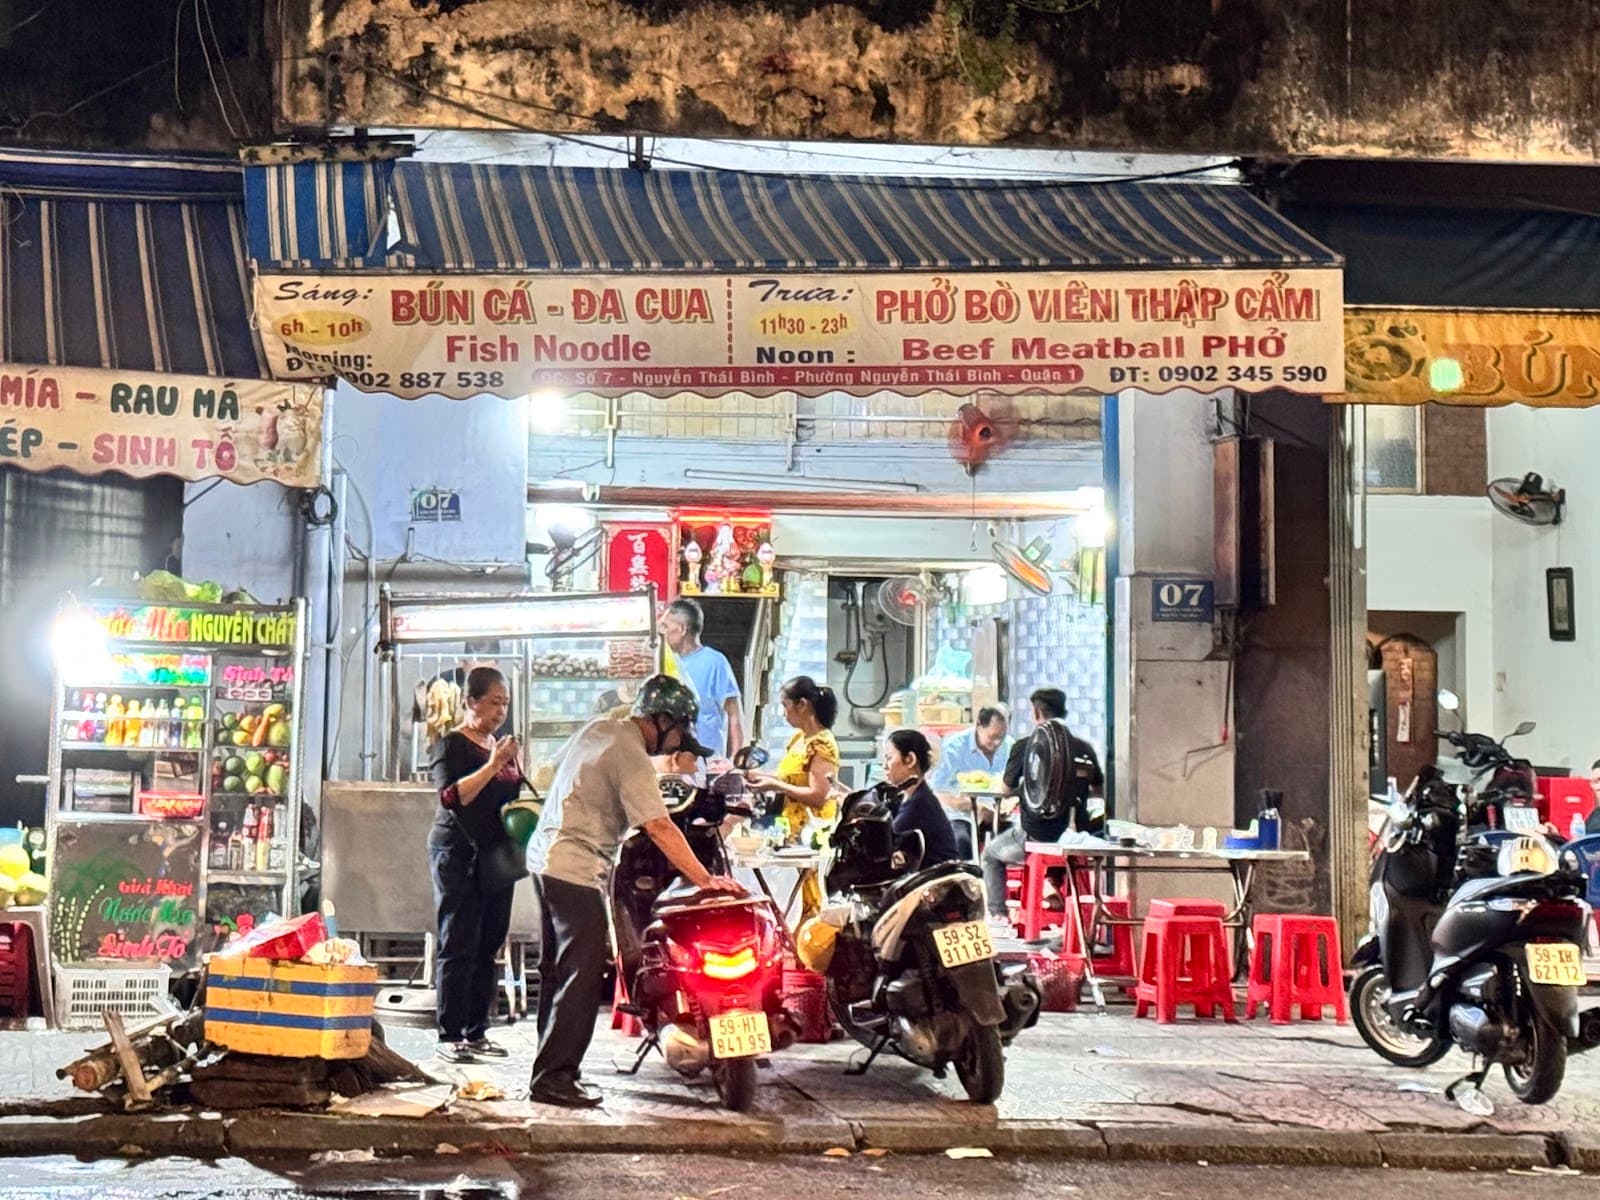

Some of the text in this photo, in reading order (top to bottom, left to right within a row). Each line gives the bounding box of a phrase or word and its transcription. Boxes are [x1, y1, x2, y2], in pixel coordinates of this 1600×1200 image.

[273, 281, 374, 306] Sáng:
[748, 278, 854, 302] Trưa:
[876, 271, 1320, 328] PHỞ BÒ VIÊN THẬP CẨM
[391, 280, 473, 325] BÚN
[483, 280, 536, 324] CÁ
[572, 287, 626, 324] ĐA
[635, 287, 713, 324] CUA
[280, 318, 304, 337] 6h
[327, 318, 363, 337] 10h
[760, 313, 805, 335] 11h30
[821, 313, 848, 335] 23h
[446, 334, 651, 362] Fish Noodle
[756, 346, 834, 364] Noon
[903, 327, 1288, 361] Beef Meatball PHỞ
[400, 371, 446, 388] 887
[457, 370, 504, 387] 538
[603, 371, 612, 385] 7
[633, 369, 692, 387] Nguyễn
[699, 369, 733, 385] Thái
[740, 369, 775, 384] Bình
[795, 368, 852, 386] Phường
[861, 367, 919, 386] Nguyễn
[926, 368, 960, 383] Thái
[967, 367, 1001, 382] Bình
[1068, 369, 1076, 381] 1
[1109, 365, 1327, 383] ĐT: 0902 345 590
[0, 368, 60, 409] MÍA
[110, 383, 179, 416] RAU
[193, 382, 240, 420] MÁ
[92, 432, 177, 468] SINH
[191, 425, 237, 472] TỐ
[421, 493, 452, 509] 07
[1160, 583, 1205, 606] 07
[190, 609, 254, 645] NGUYÊN
[255, 610, 297, 646] CHẤT
